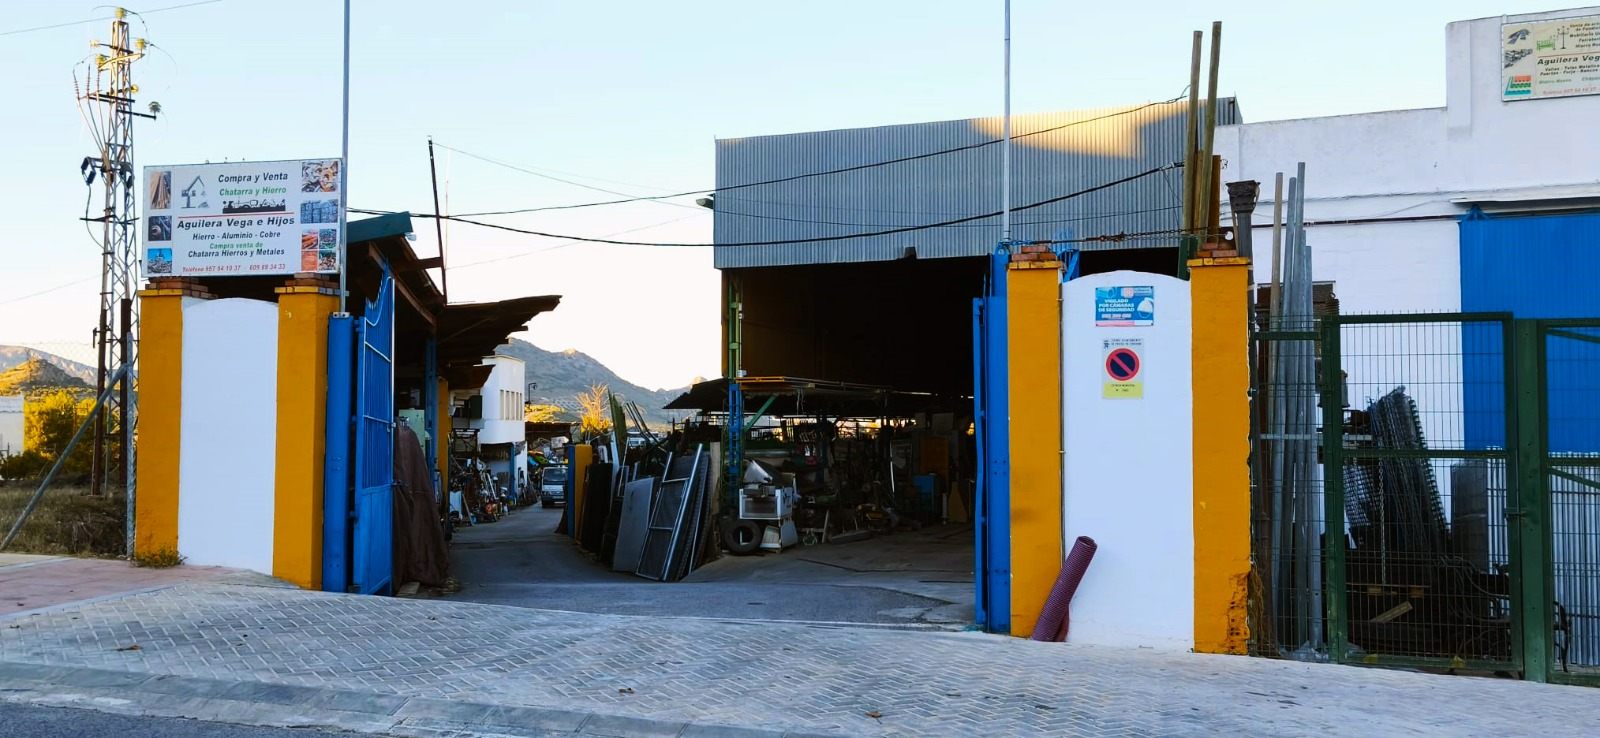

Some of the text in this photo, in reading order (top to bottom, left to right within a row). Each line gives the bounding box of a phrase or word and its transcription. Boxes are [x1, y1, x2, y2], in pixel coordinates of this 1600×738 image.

[1537, 57, 1578, 66] Aguilera
[218, 172, 288, 184] Compra y Venta
[219, 186, 287, 196] Chatarra y Hierro
[177, 216, 295, 230] Aguilera Vega e Hijos
[193, 233, 215, 241] Hierro
[222, 232, 253, 240] Aluminio
[259, 231, 281, 239] Cobre
[210, 242, 234, 250] Compra
[188, 248, 285, 258] Chatarra Hierros y Metales
